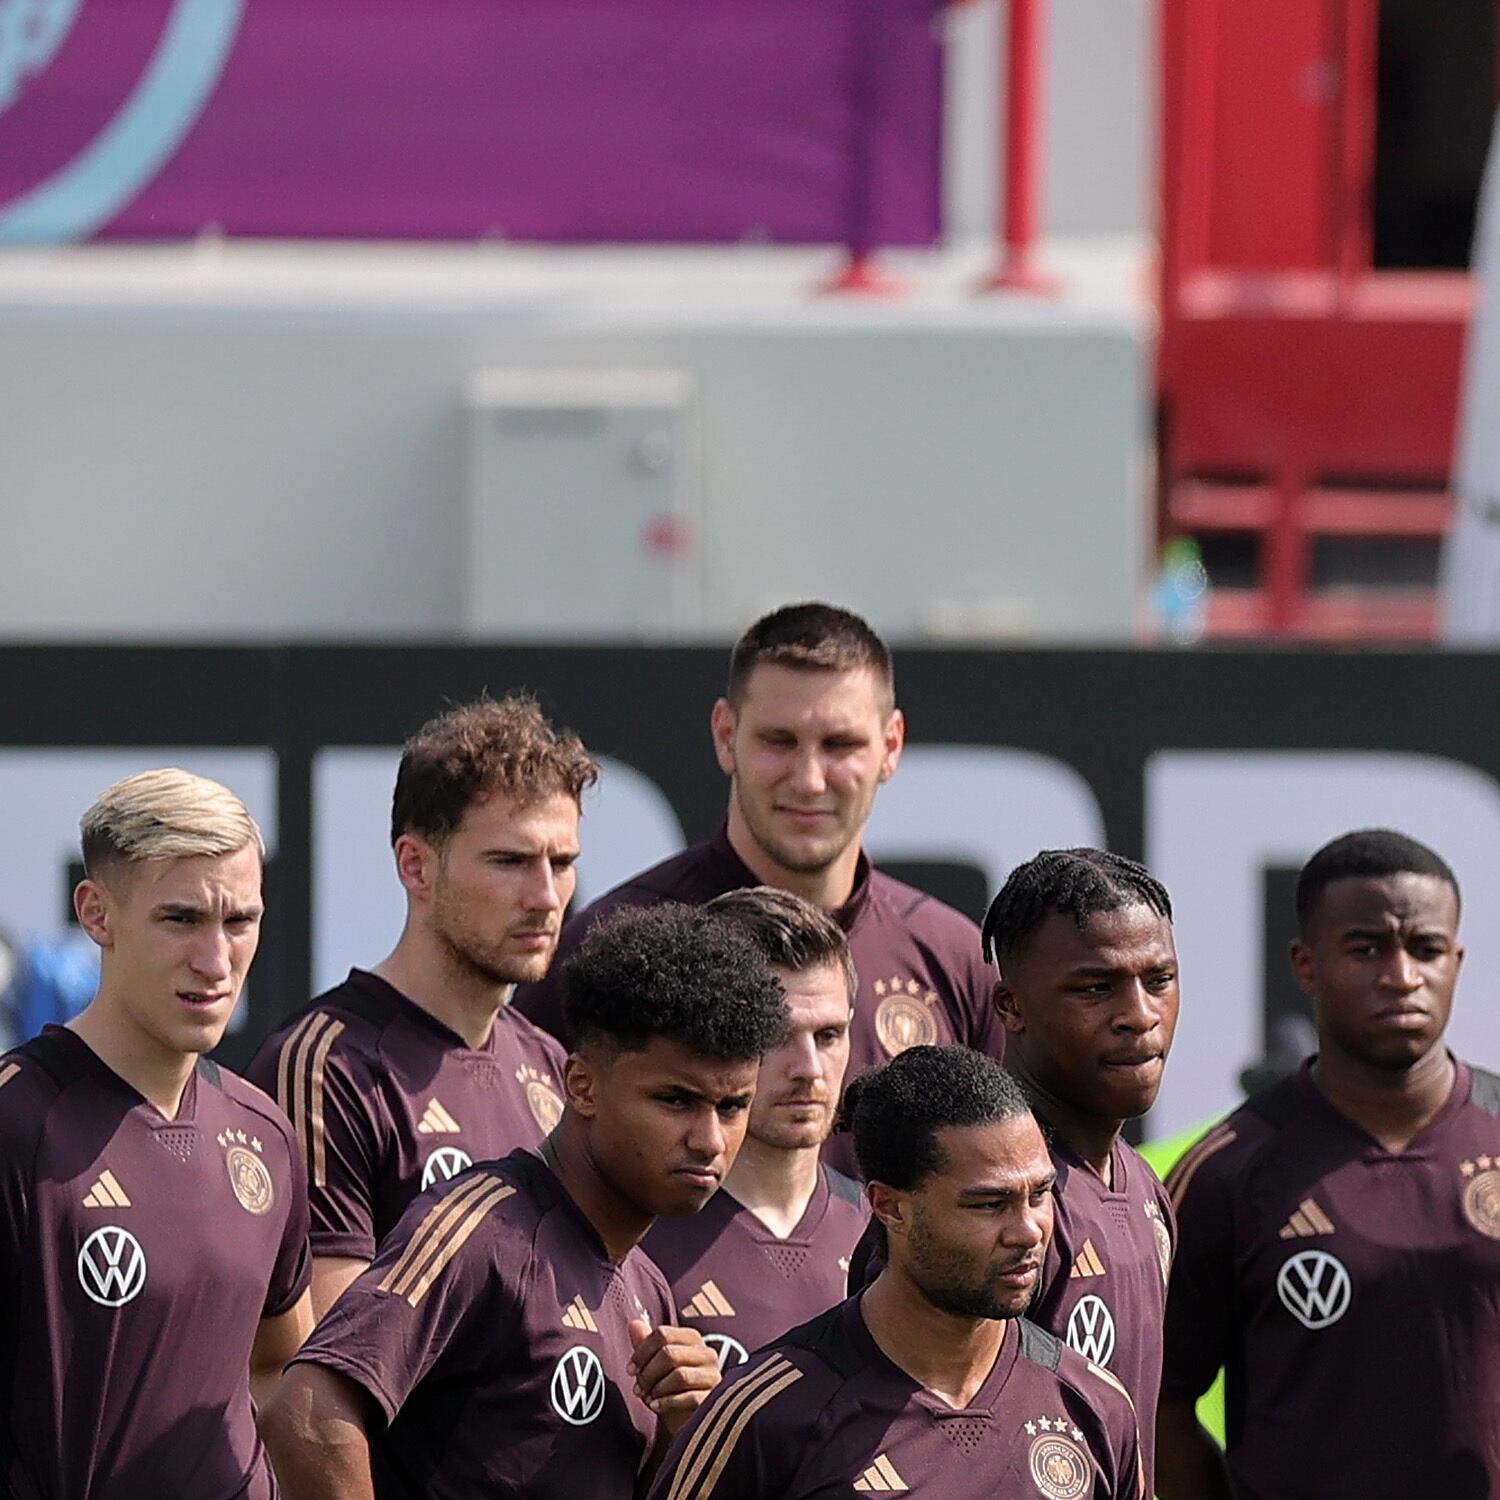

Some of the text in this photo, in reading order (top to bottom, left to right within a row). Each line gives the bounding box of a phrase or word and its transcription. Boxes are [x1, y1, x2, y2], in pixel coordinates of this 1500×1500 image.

[79, 1227, 146, 1305] VW
[1277, 1250, 1350, 1329] VW
[552, 1347, 604, 1424] VW
